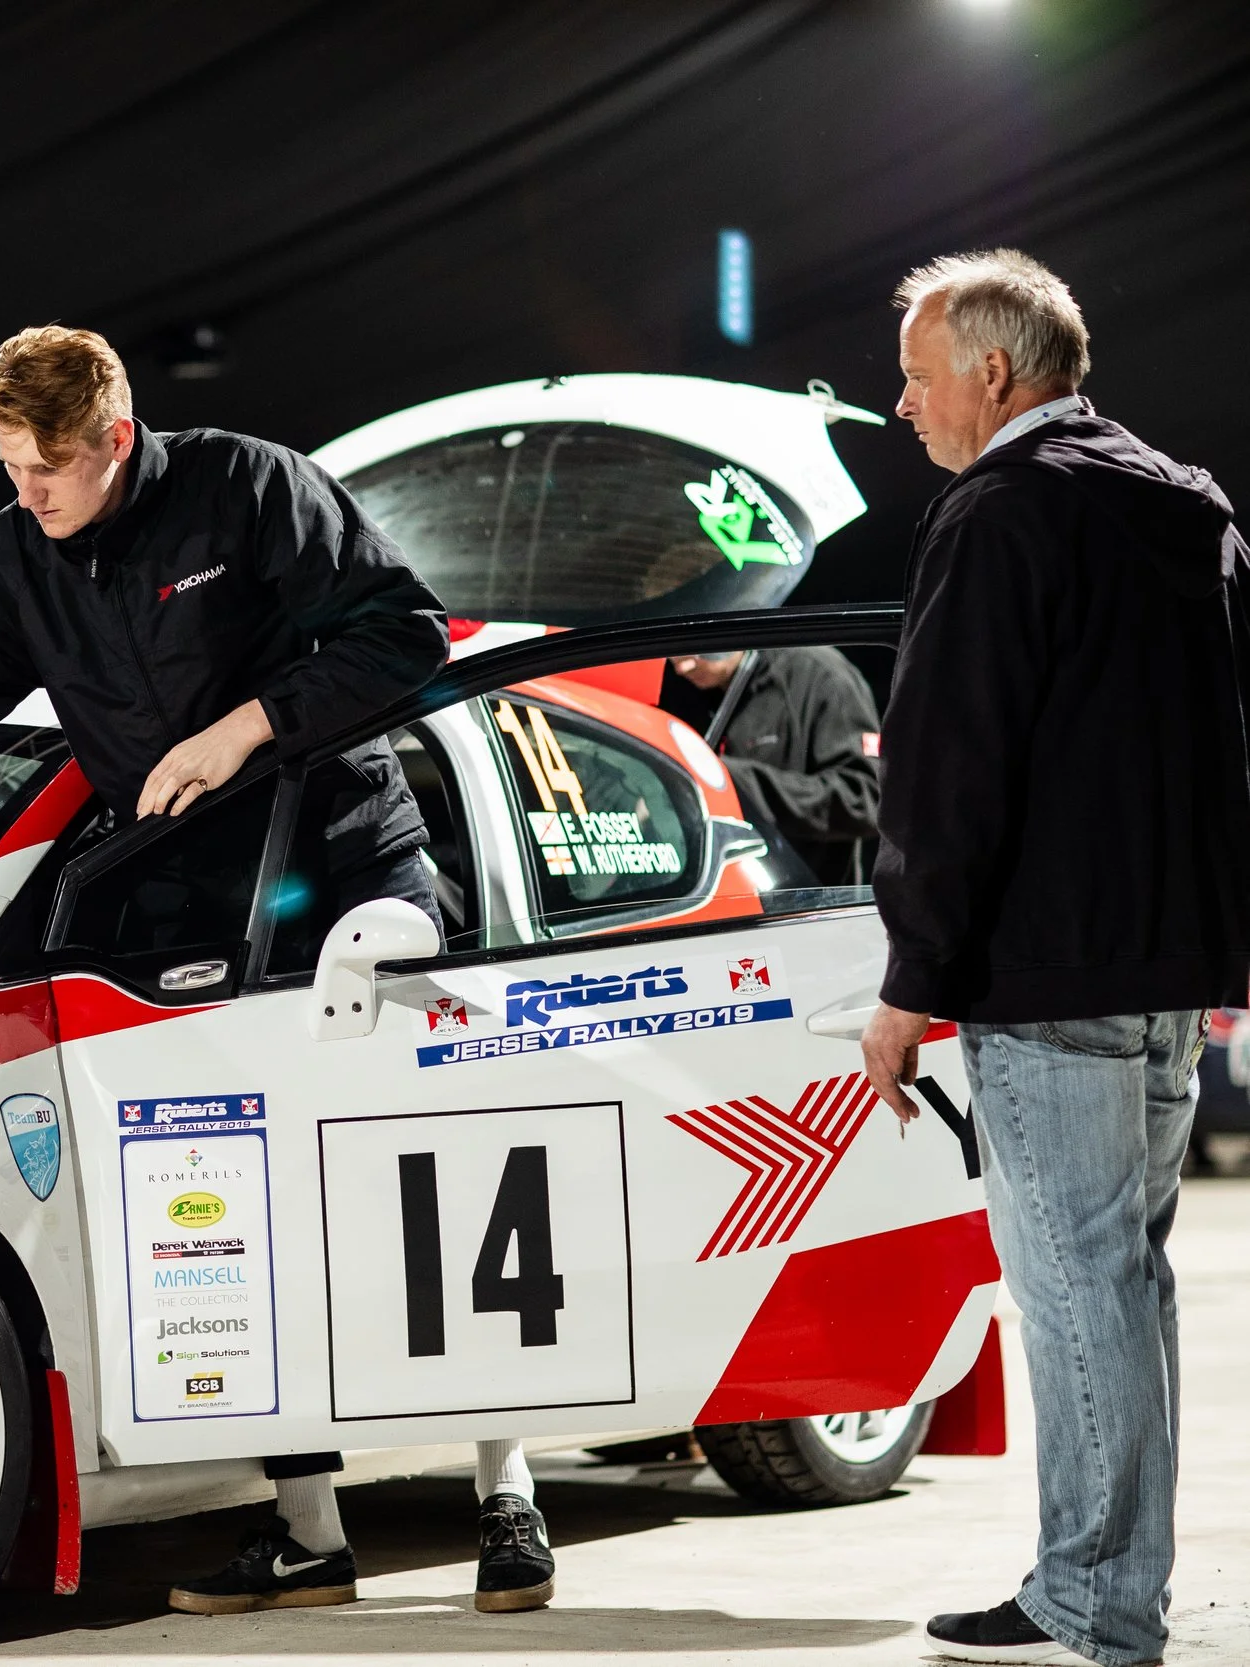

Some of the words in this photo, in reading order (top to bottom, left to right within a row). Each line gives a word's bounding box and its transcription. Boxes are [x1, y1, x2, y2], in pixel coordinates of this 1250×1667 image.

[173, 563, 226, 594] YOKOHAMA
[494, 699, 588, 816] 14
[560, 813, 585, 843] E.
[579, 812, 644, 843] FOSSEY
[572, 845, 596, 874] W.
[591, 842, 681, 874] RUTHERFORD
[506, 966, 689, 1028] Roberts
[442, 1029, 565, 1064] JERSEY
[568, 1015, 667, 1046] RALLY
[673, 1004, 754, 1031] 2019
[7, 1110, 51, 1124] TeamBU
[154, 1101, 227, 1124] Roberts
[128, 1125, 175, 1134] JERSEY
[178, 1122, 216, 1132] RALLY
[219, 1121, 251, 1129] 2019
[148, 1169, 242, 1183] ROMERILS
[172, 1201, 220, 1217] ERNIE'S
[152, 1241, 189, 1251] Derek
[192, 1238, 245, 1249] Warwick
[398, 1146, 564, 1358] 14
[154, 1266, 246, 1289] MANSELL
[157, 1298, 176, 1308] THE
[180, 1294, 248, 1306] COLLECTION
[156, 1316, 249, 1340] Jacksons
[176, 1351, 199, 1361] Sign
[201, 1349, 250, 1358] Solutions
[190, 1380, 220, 1392] SGB
